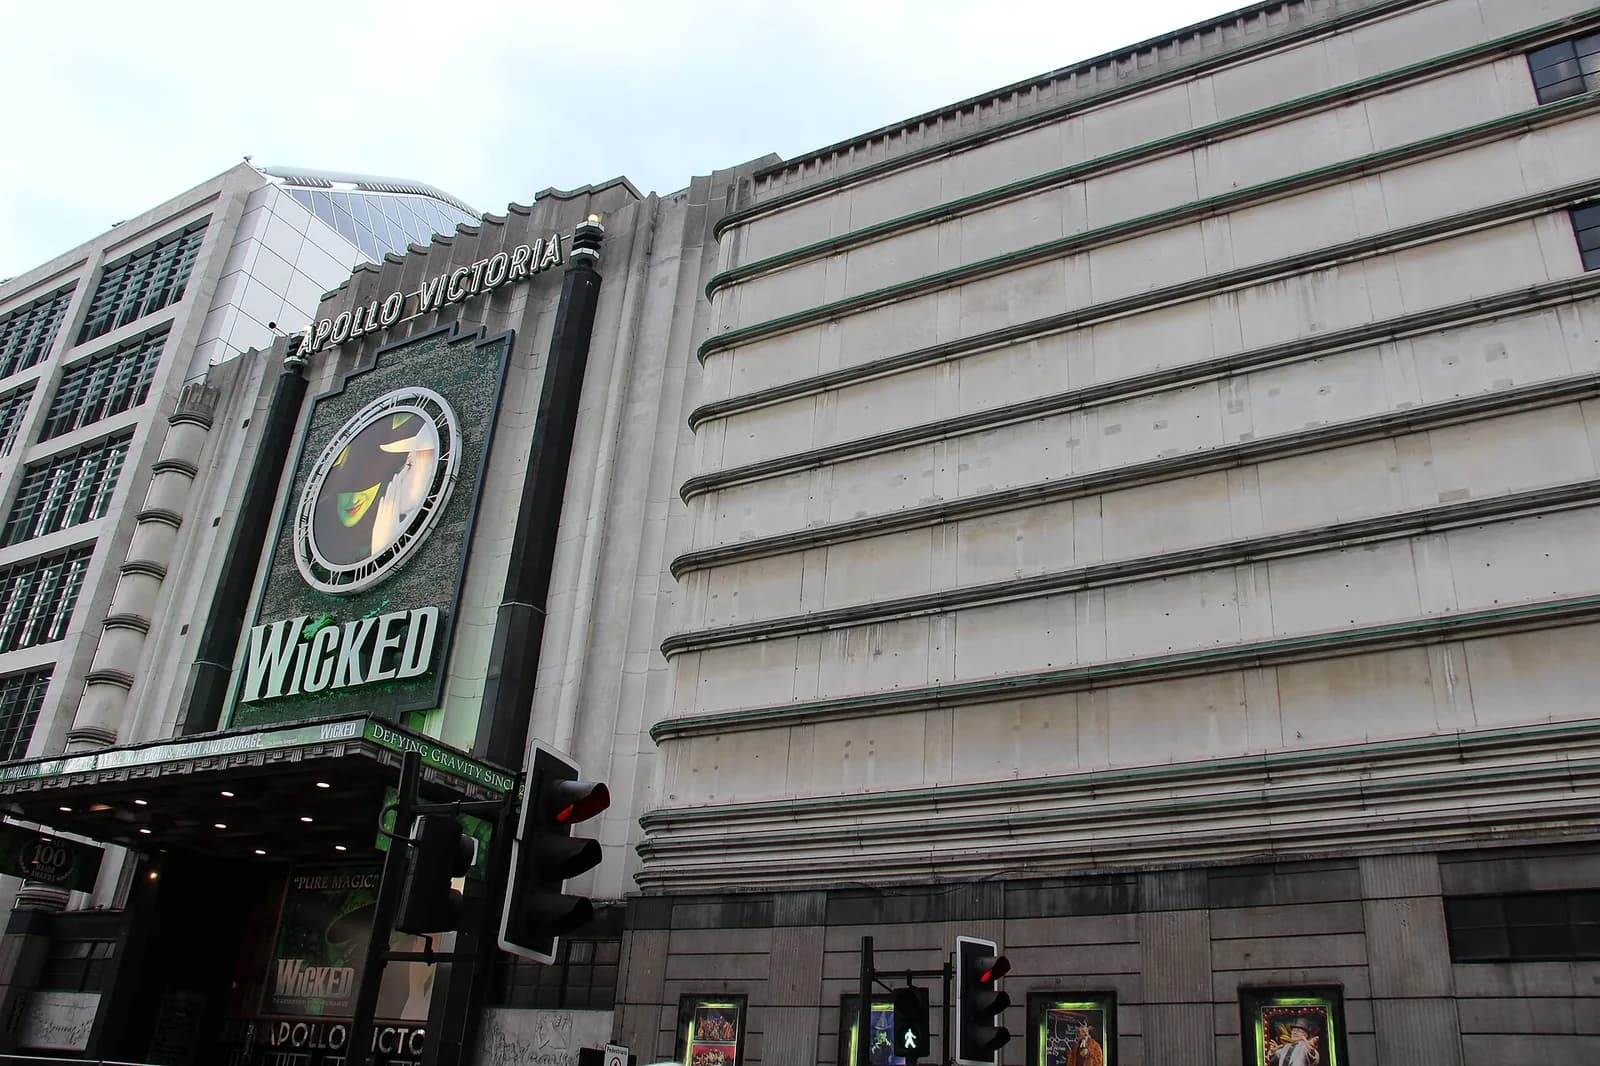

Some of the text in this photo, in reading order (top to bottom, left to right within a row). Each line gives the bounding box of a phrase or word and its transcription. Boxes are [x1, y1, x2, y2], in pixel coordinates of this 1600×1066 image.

[297, 233, 562, 356] APOLLO VICTORIA
[7, 763, 39, 779] THRILLING
[176, 742, 202, 758] HEART
[204, 738, 221, 754] AND
[372, 724, 429, 757] DEFYING
[431, 748, 484, 779] GRAVITY
[371, 1026, 426, 1055] ICTO
